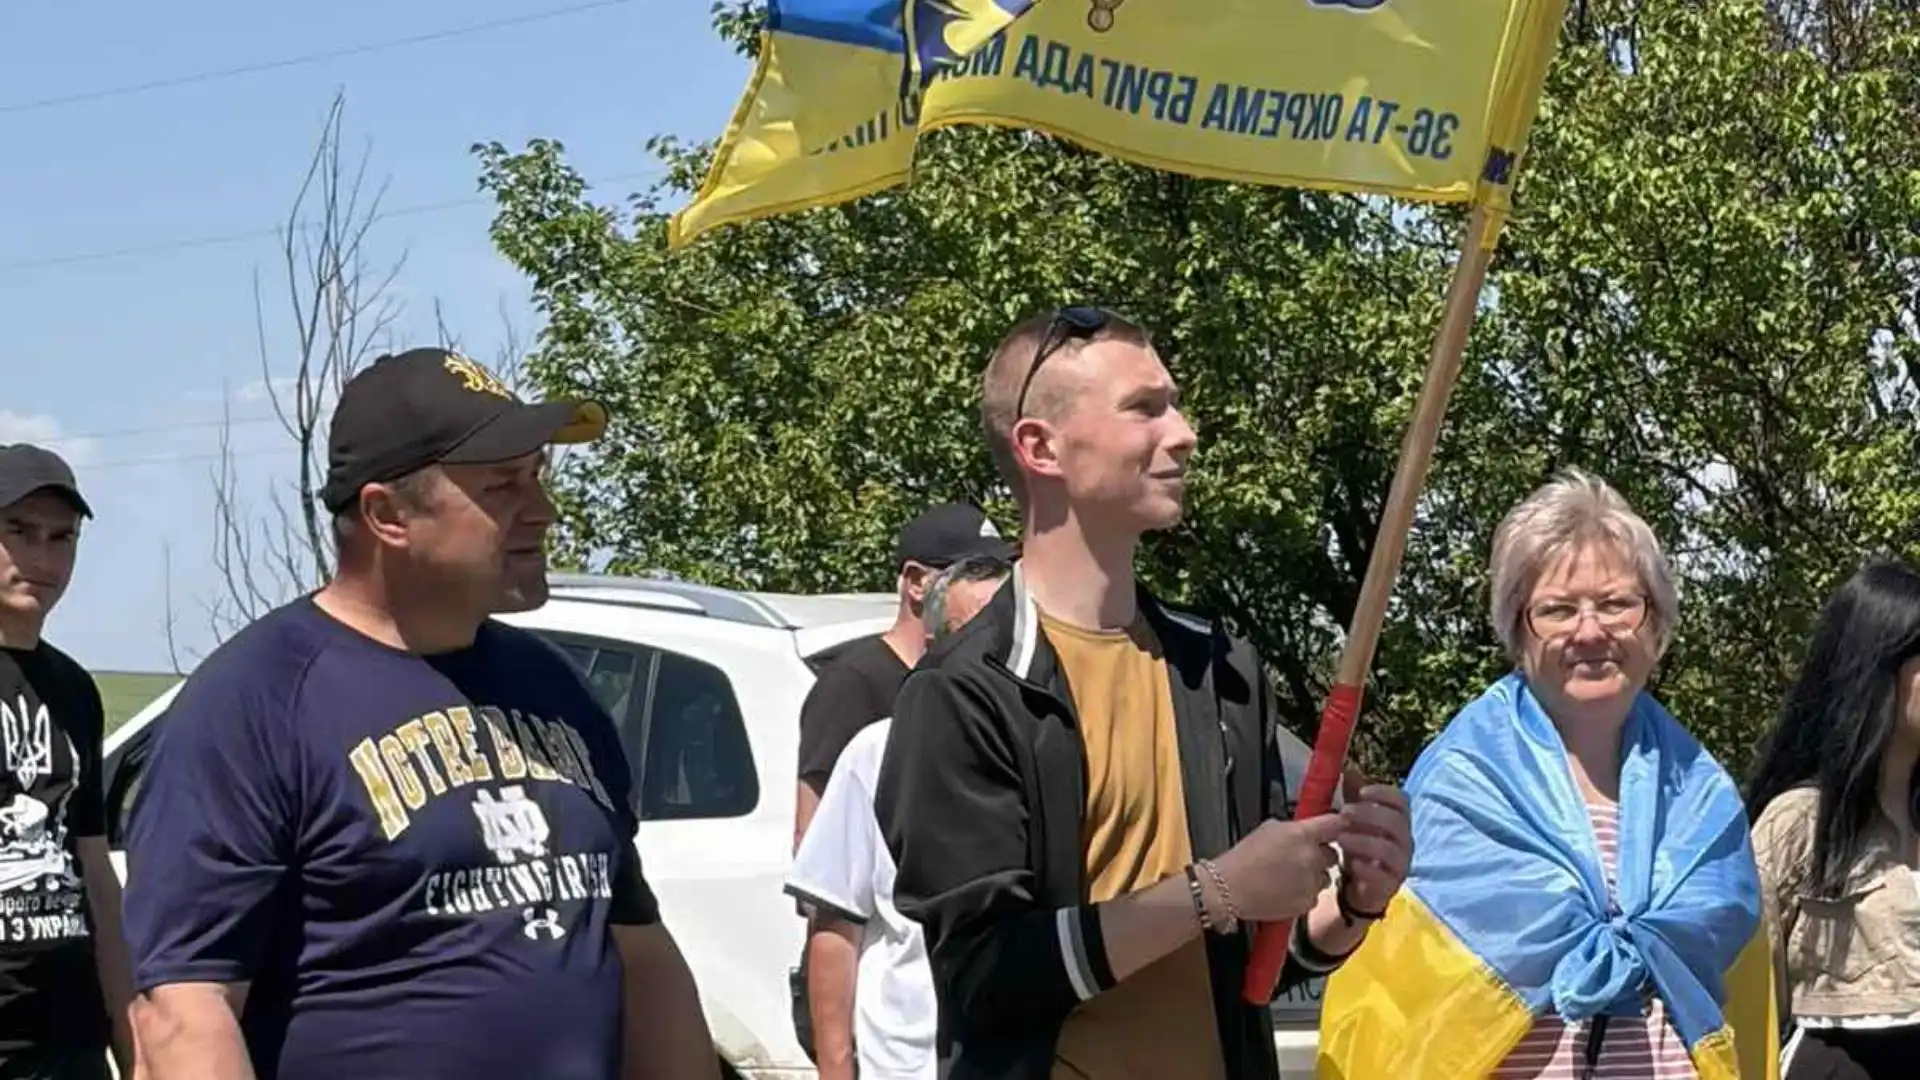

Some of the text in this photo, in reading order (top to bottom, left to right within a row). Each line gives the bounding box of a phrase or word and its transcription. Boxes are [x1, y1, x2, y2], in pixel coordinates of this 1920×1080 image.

[349, 706, 493, 841] NOTRE
[426, 853, 612, 915] FIGHTING IRISH
